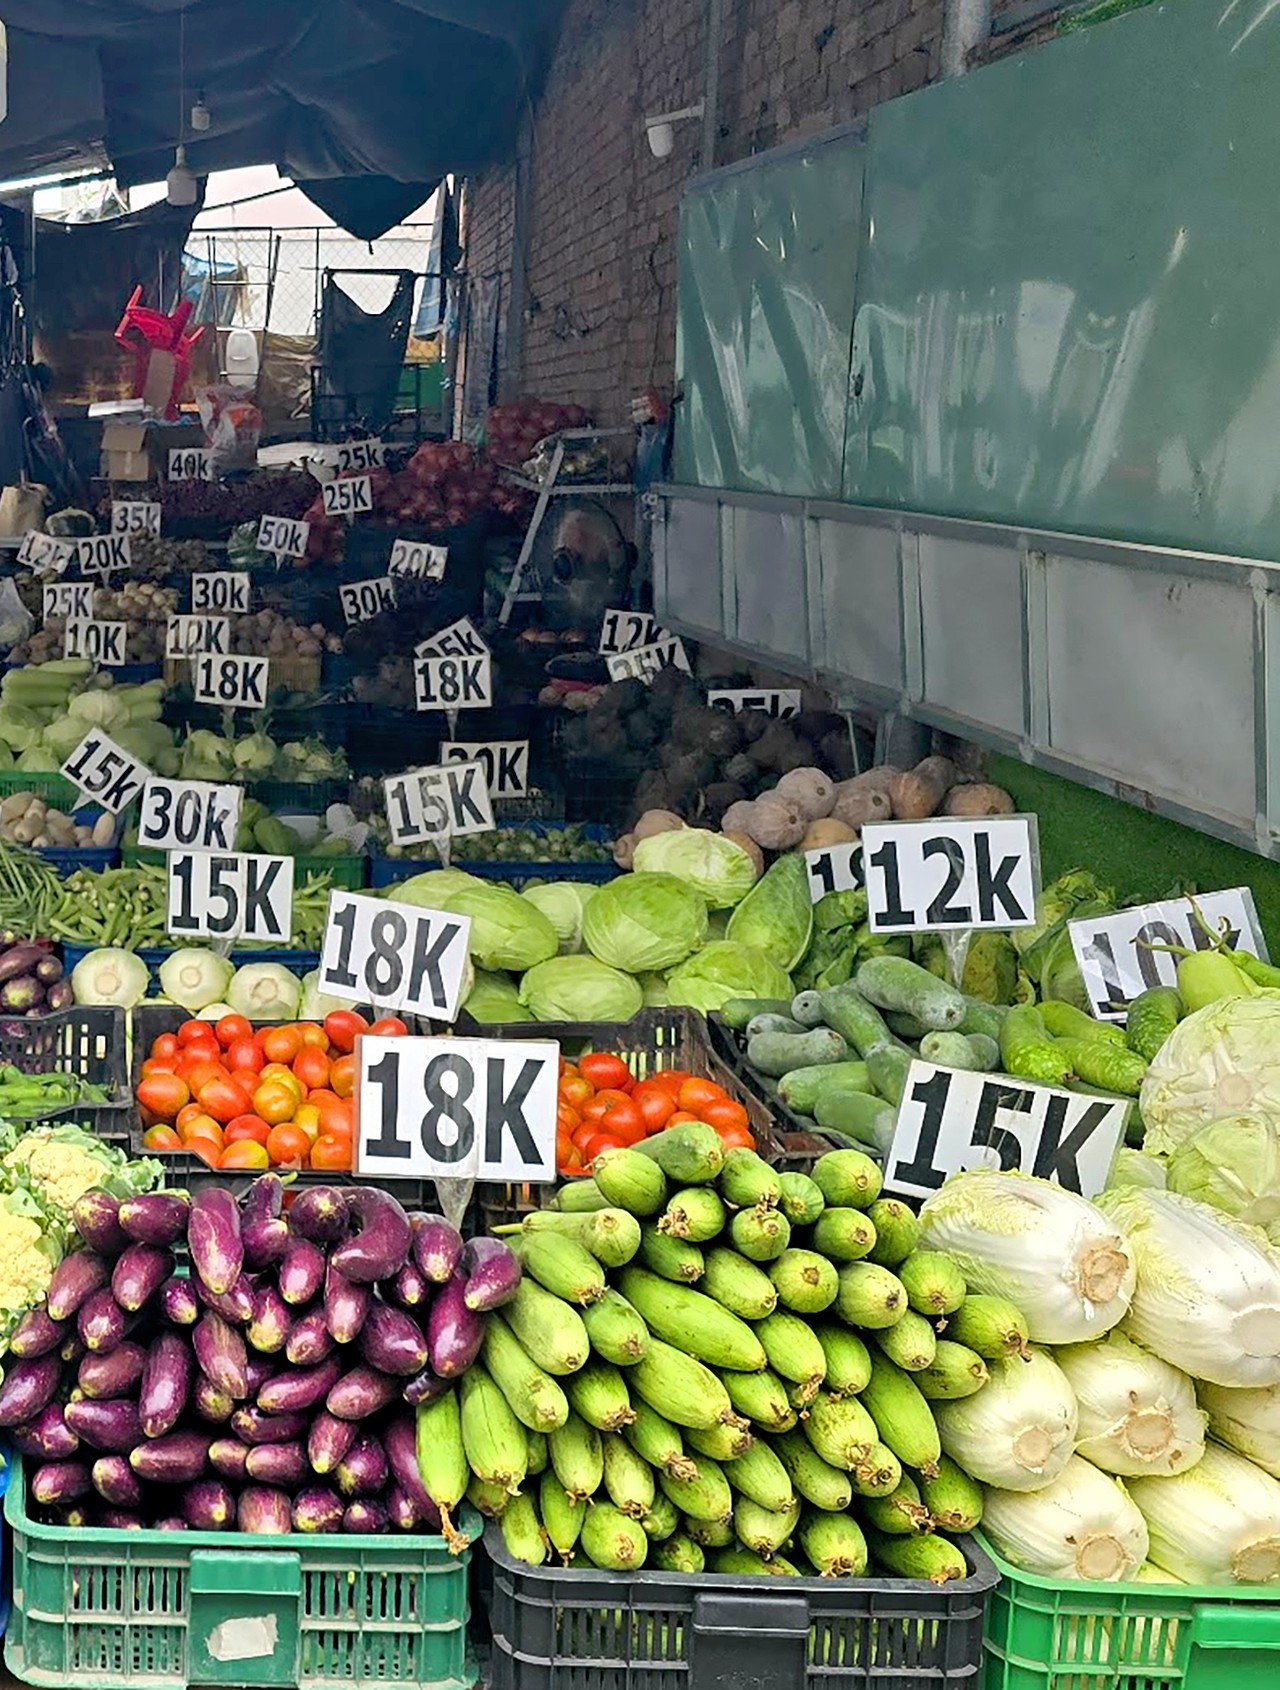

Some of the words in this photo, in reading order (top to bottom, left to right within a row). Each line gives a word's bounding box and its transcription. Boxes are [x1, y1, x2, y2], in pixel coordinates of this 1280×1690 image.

[171, 452, 208, 478] 40k
[338, 444, 380, 471] 25k
[324, 480, 368, 510] 25K
[115, 505, 158, 534] 35k
[259, 520, 302, 552] 50k
[81, 538, 127, 570] 20K
[46, 587, 90, 617] 25K
[195, 577, 244, 610] 30k
[343, 581, 397, 619] 30k
[68, 623, 122, 660] 10K
[422, 629, 485, 657] 5k
[200, 658, 264, 703] 18K
[417, 660, 487, 703] 18K
[64, 739, 138, 809] 15k
[144, 786, 233, 849] 30k
[391, 768, 487, 837] 15K
[172, 855, 283, 935] 15K
[870, 832, 1027, 927] 12k
[325, 903, 462, 1009] 18K
[366, 1052, 546, 1165] 18K
[894, 1070, 1115, 1197] 15K
